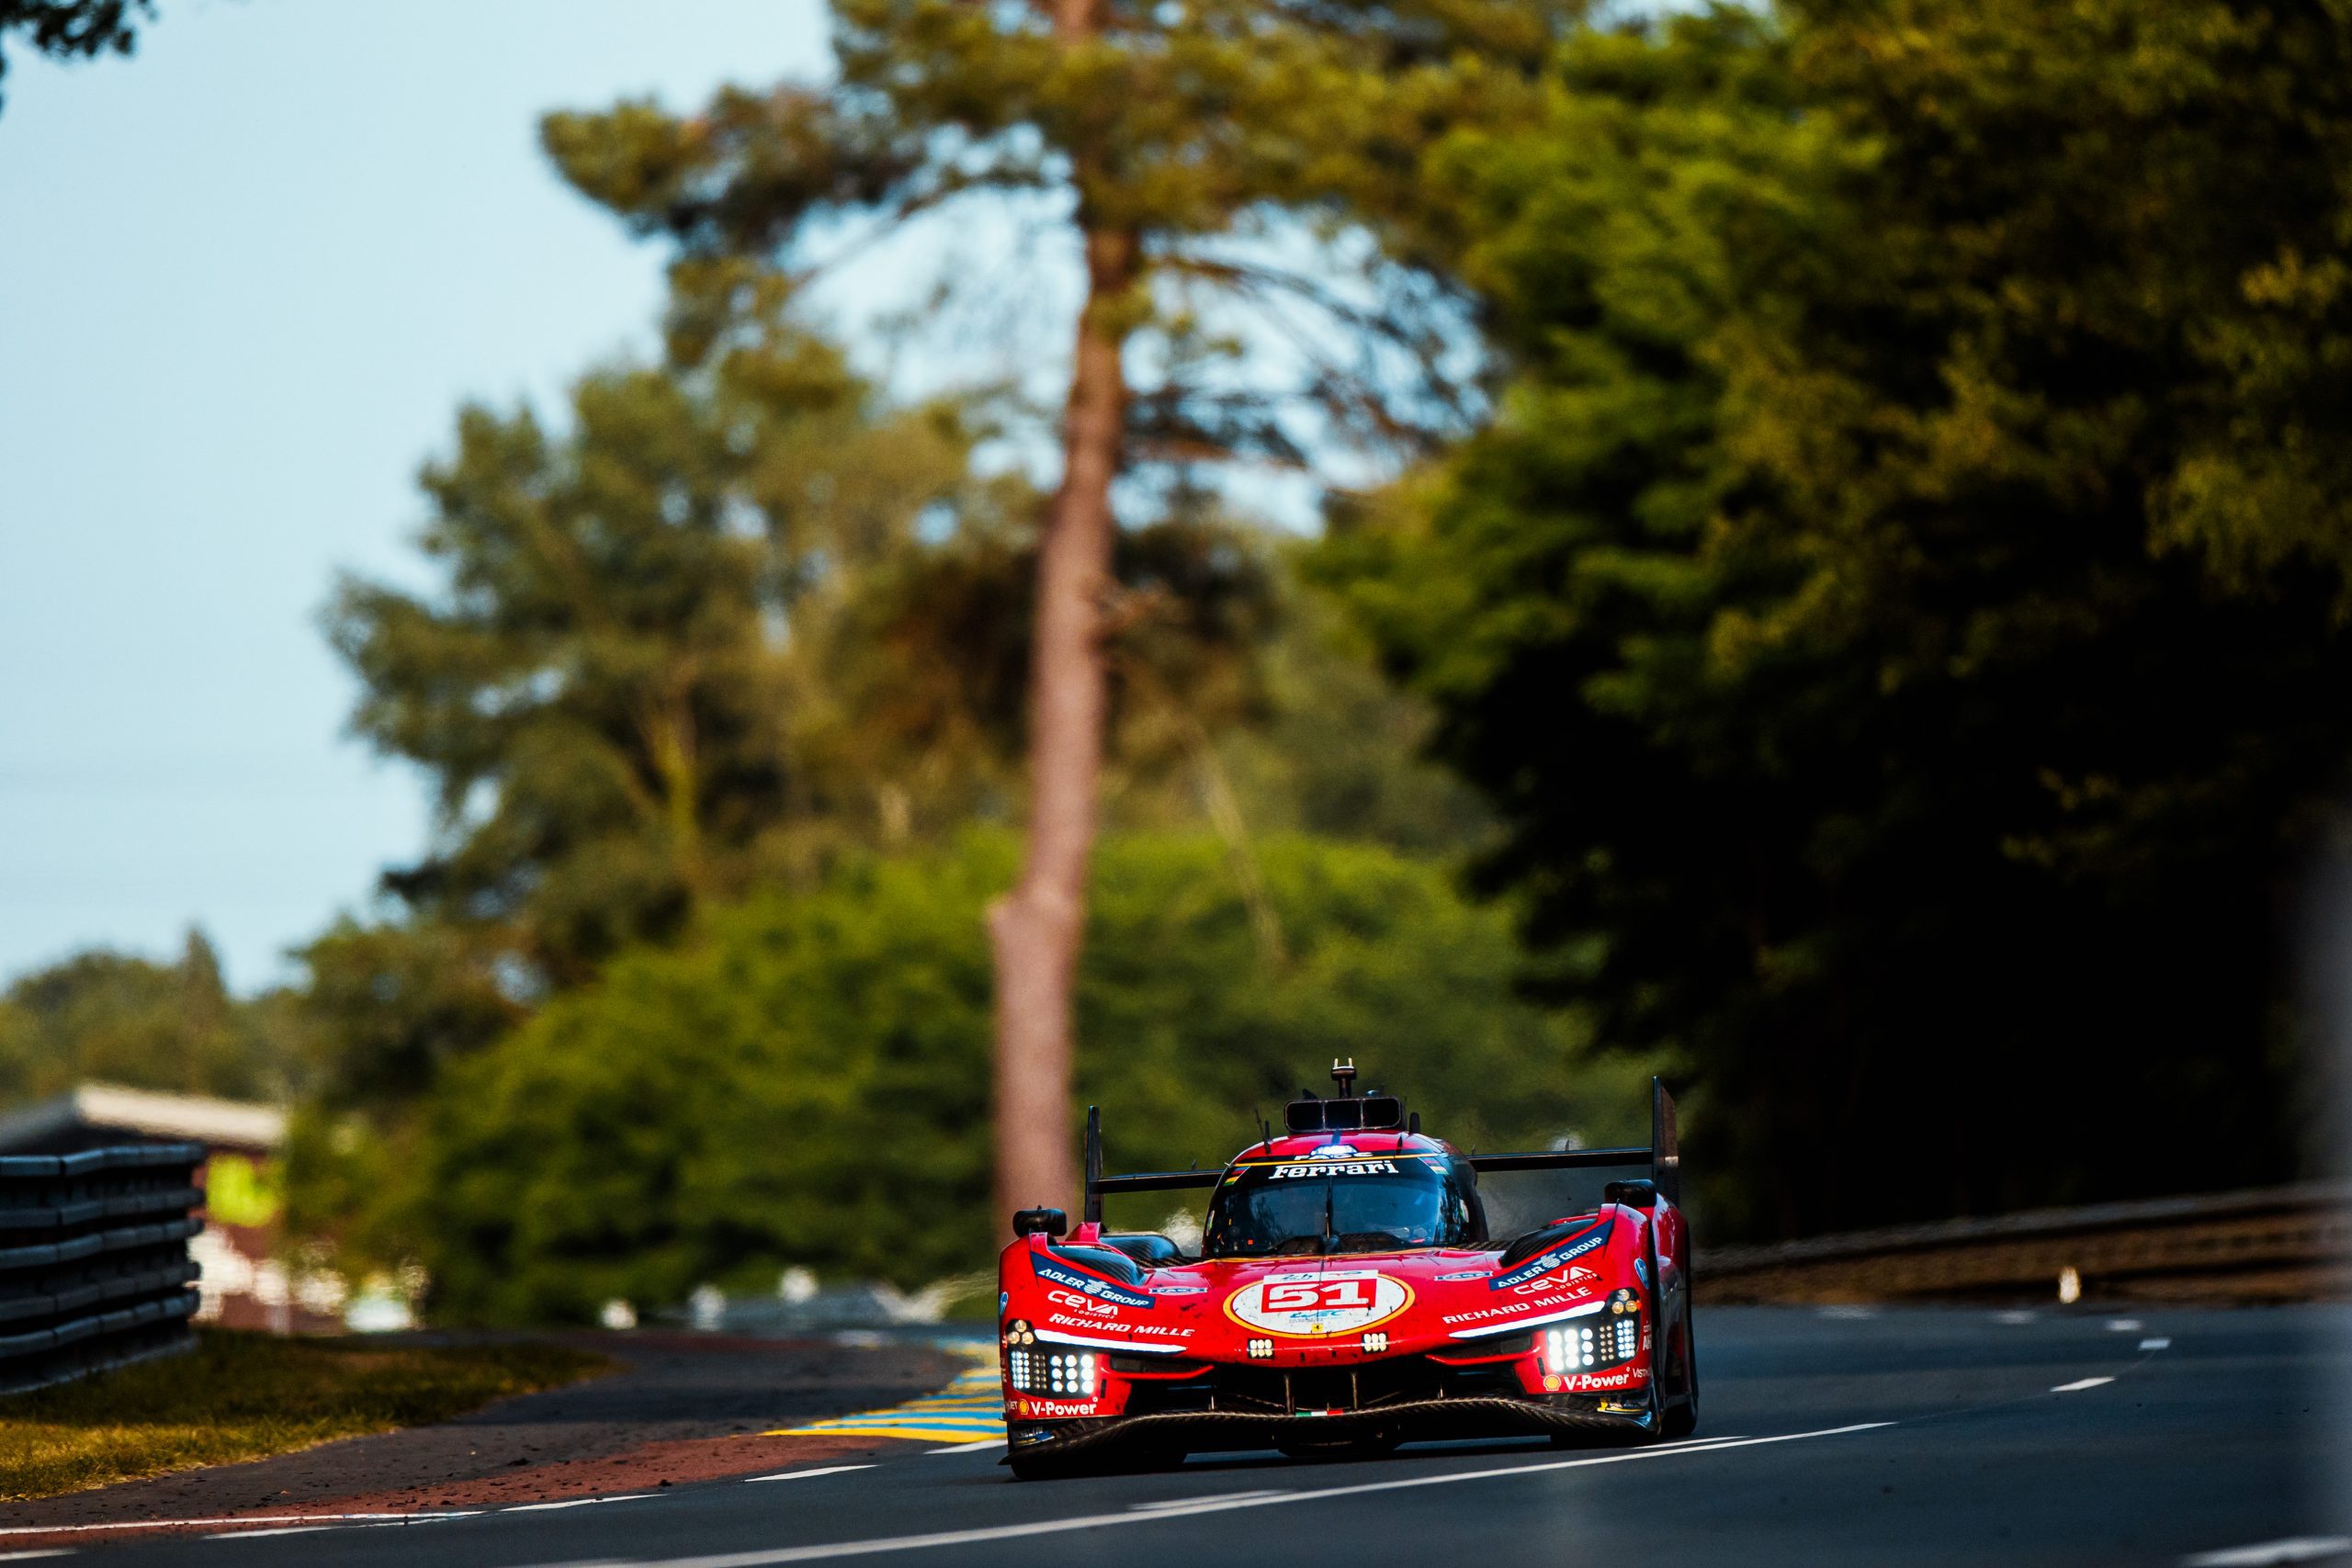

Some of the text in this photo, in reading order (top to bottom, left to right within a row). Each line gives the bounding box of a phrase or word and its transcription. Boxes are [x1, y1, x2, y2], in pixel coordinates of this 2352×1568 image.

[1269, 1160, 1399, 1179] Ferrari
[1498, 1236, 1602, 1288] ADLER GROUP
[1038, 1269, 1149, 1307] ADLER GROUP
[1555, 1273, 1598, 1291] LOGISTICS
[1268, 1281, 1369, 1309] 51
[1442, 1286, 1592, 1325] RICHARD MILLE
[1073, 1308, 1115, 1319] LOGISTICS
[1049, 1313, 1195, 1337] RICHARD MILLE
[1564, 1373, 1630, 1391] V-Power
[1030, 1401, 1097, 1416] V-Power
